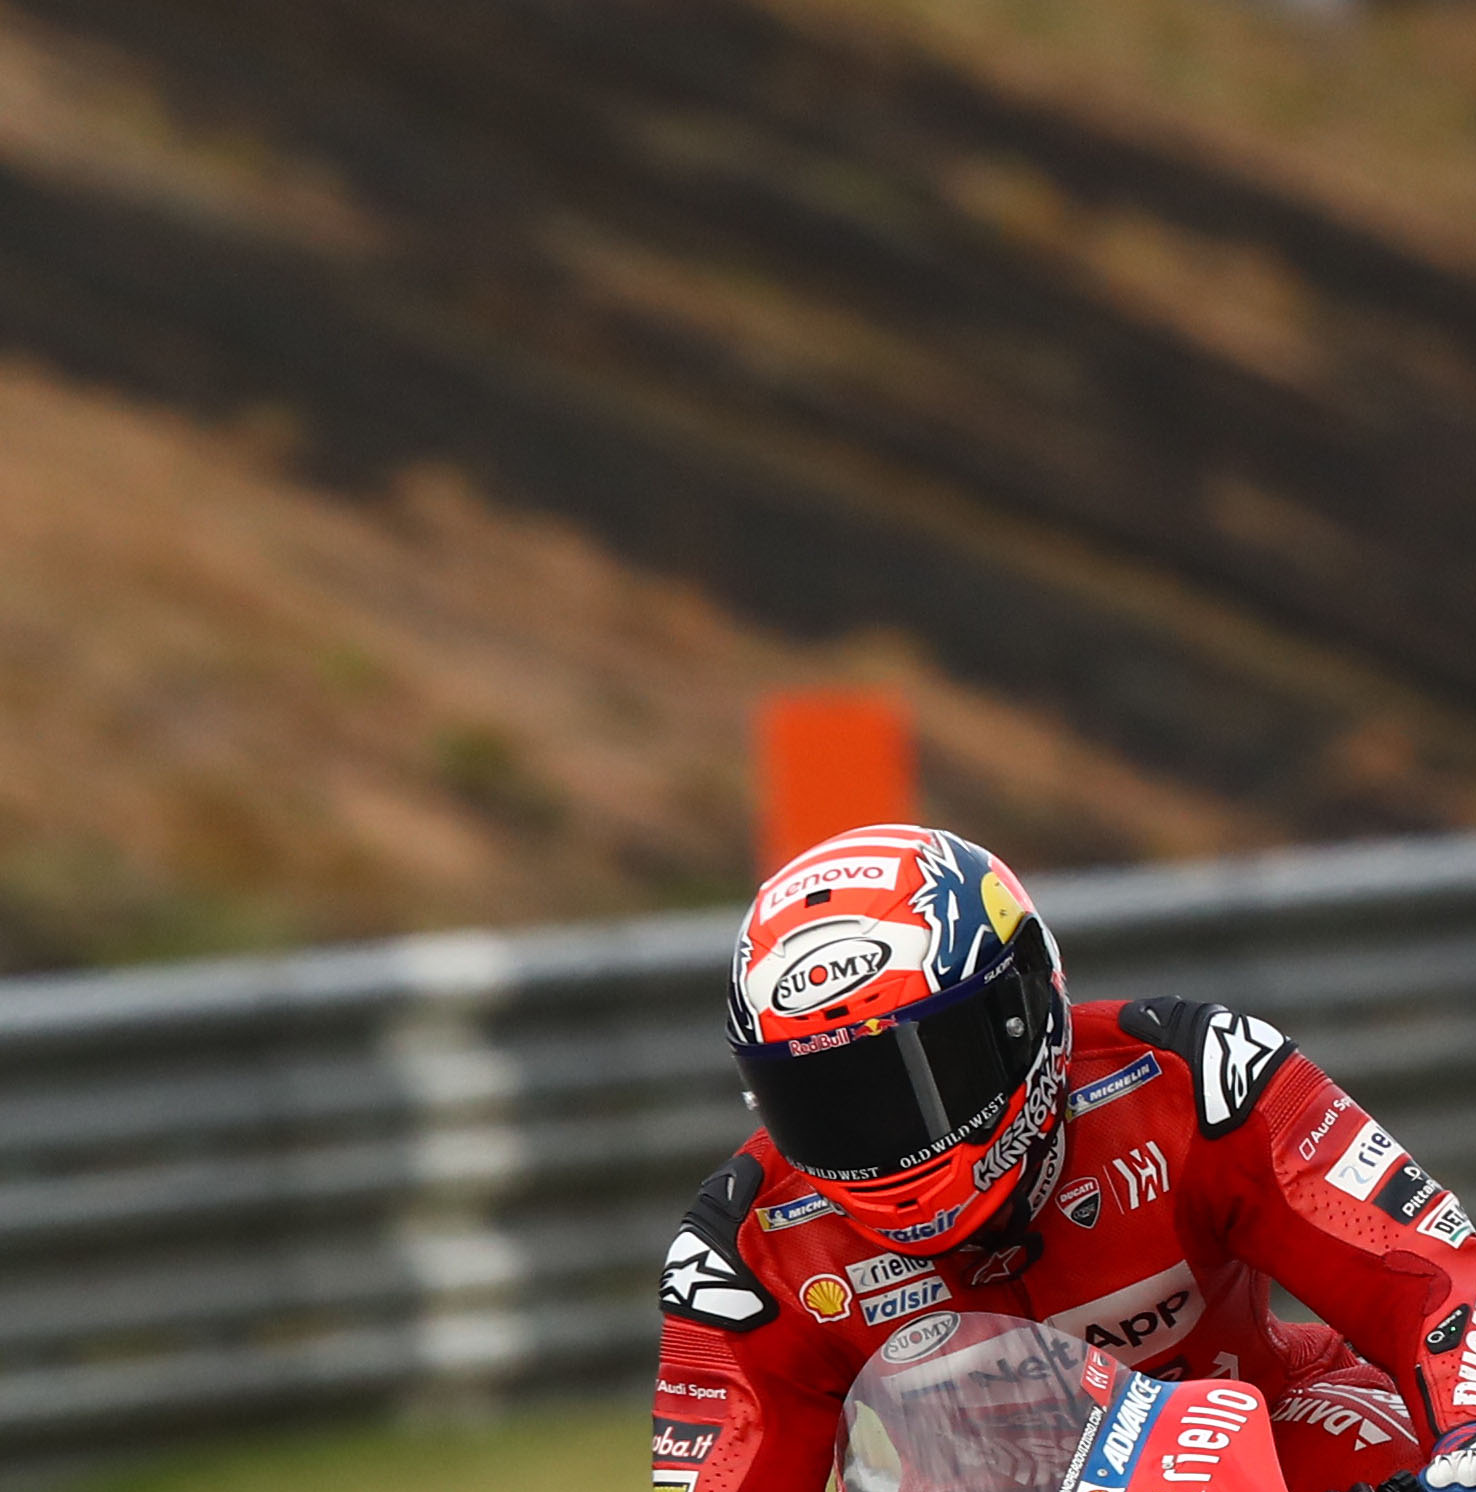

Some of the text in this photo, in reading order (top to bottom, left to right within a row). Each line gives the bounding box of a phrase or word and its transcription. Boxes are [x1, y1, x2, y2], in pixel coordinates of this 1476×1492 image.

[770, 866, 884, 908] Lenovo
[778, 952, 879, 999] SUOMY
[1089, 1063, 1150, 1101] MICHELIN
[900, 1092, 1007, 1169] OLD WILD WEST
[1310, 1108, 1339, 1144] Audi
[807, 1166, 838, 1181] WILD
[837, 1166, 880, 1181] WEST
[1059, 1181, 1095, 1204] DUCATI
[864, 1281, 943, 1323] valsir
[656, 1379, 728, 1400] Audi Sport
[1102, 1370, 1163, 1476] ADVANCE
[1162, 1387, 1260, 1484] riello
